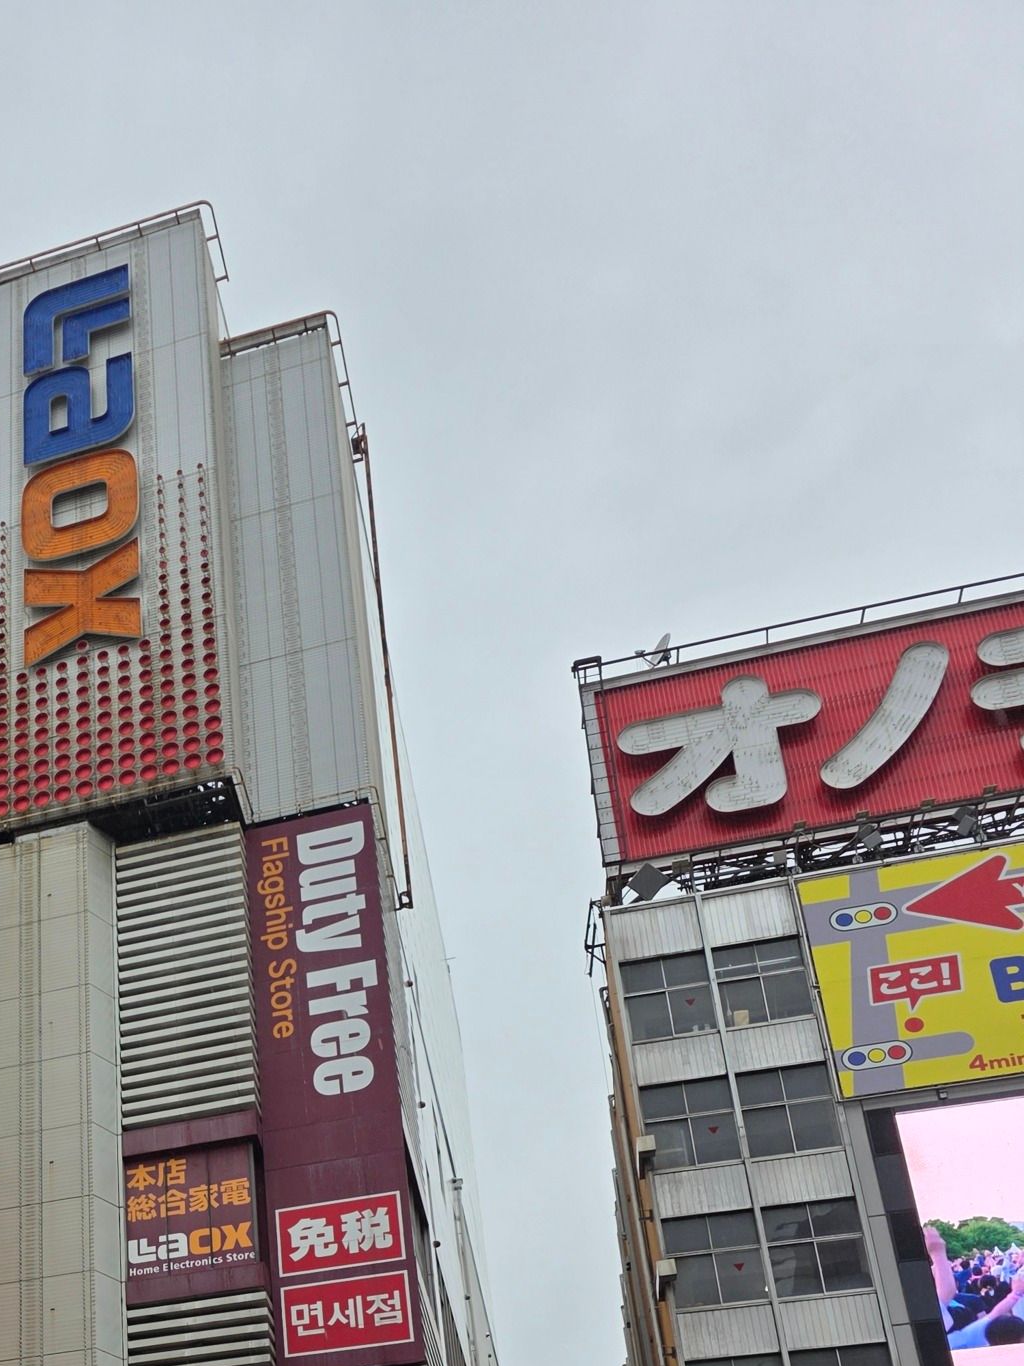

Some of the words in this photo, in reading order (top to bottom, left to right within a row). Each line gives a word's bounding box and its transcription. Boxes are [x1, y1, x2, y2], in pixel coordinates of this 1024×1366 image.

[258, 835, 290, 952] Flagship
[296, 820, 367, 954] Duty
[268, 957, 297, 1040] Store
[306, 958, 378, 1096] Free
[126, 1159, 187, 1191] 本店
[127, 1176, 251, 1221] 総合家電
[288, 1207, 395, 1263] 免税
[129, 1264, 160, 1278] Home
[162, 1255, 224, 1274] Electronics
[226, 1250, 256, 1265] Store
[291, 1289, 403, 1339] 면세점
